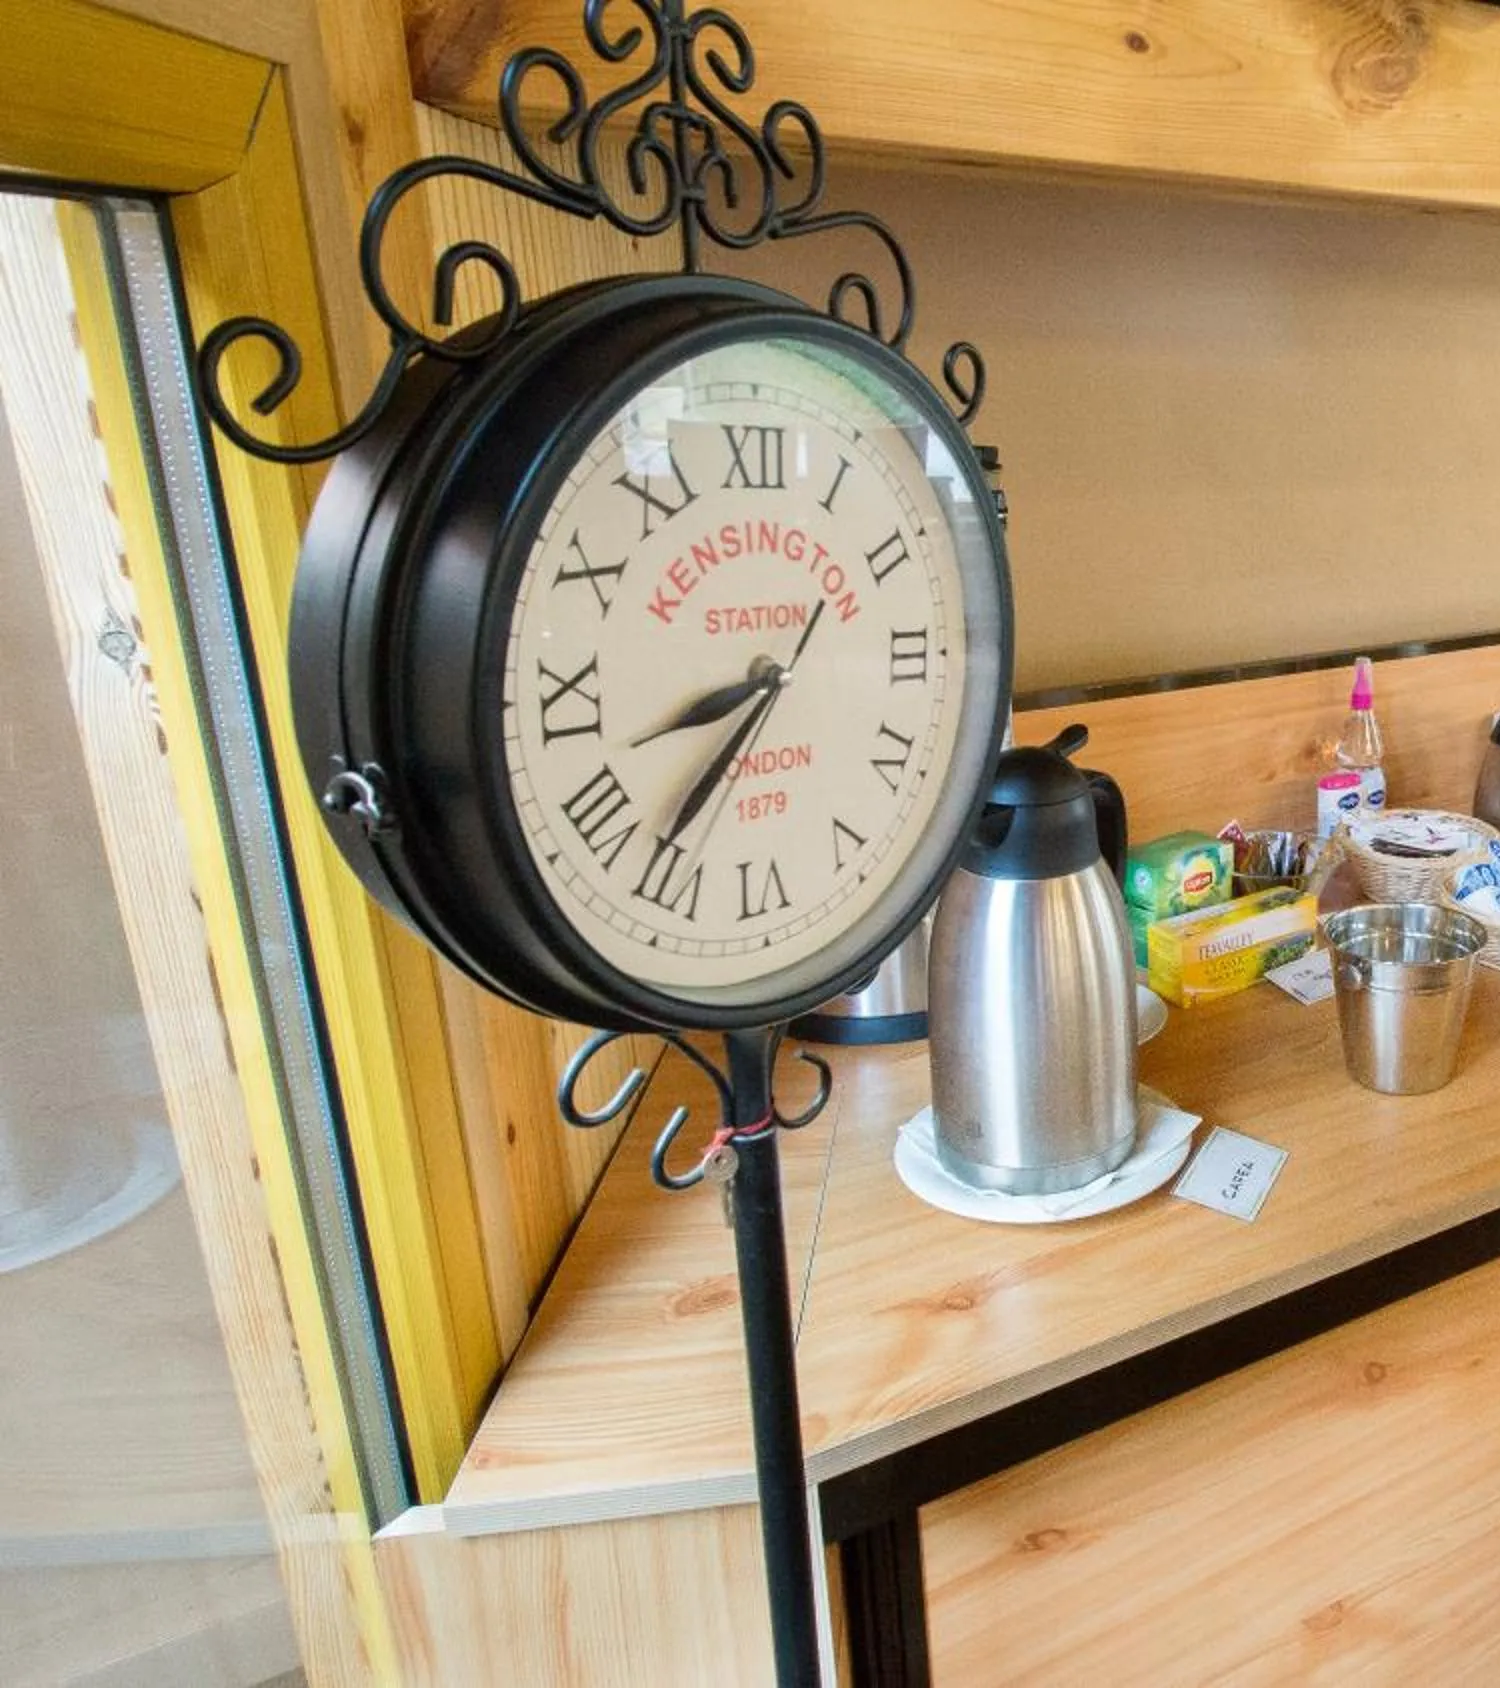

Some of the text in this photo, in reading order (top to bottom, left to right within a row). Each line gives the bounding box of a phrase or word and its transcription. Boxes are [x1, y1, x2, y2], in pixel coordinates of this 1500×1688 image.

[721, 424, 787, 489] XII
[818, 454, 853, 514] I
[611, 438, 701, 542] XI
[551, 528, 629, 619] X
[646, 520, 860, 625] KENSINGTON
[864, 527, 911, 586] II
[704, 603, 807, 635] STATION
[890, 626, 928, 685] III
[538, 652, 603, 747] IX
[725, 743, 811, 780] ONDON
[870, 721, 915, 795] IV
[560, 763, 641, 873] VIII
[737, 790, 787, 821] 1879
[832, 815, 868, 873] V
[631, 835, 703, 922] VII
[736, 859, 791, 921] VI
